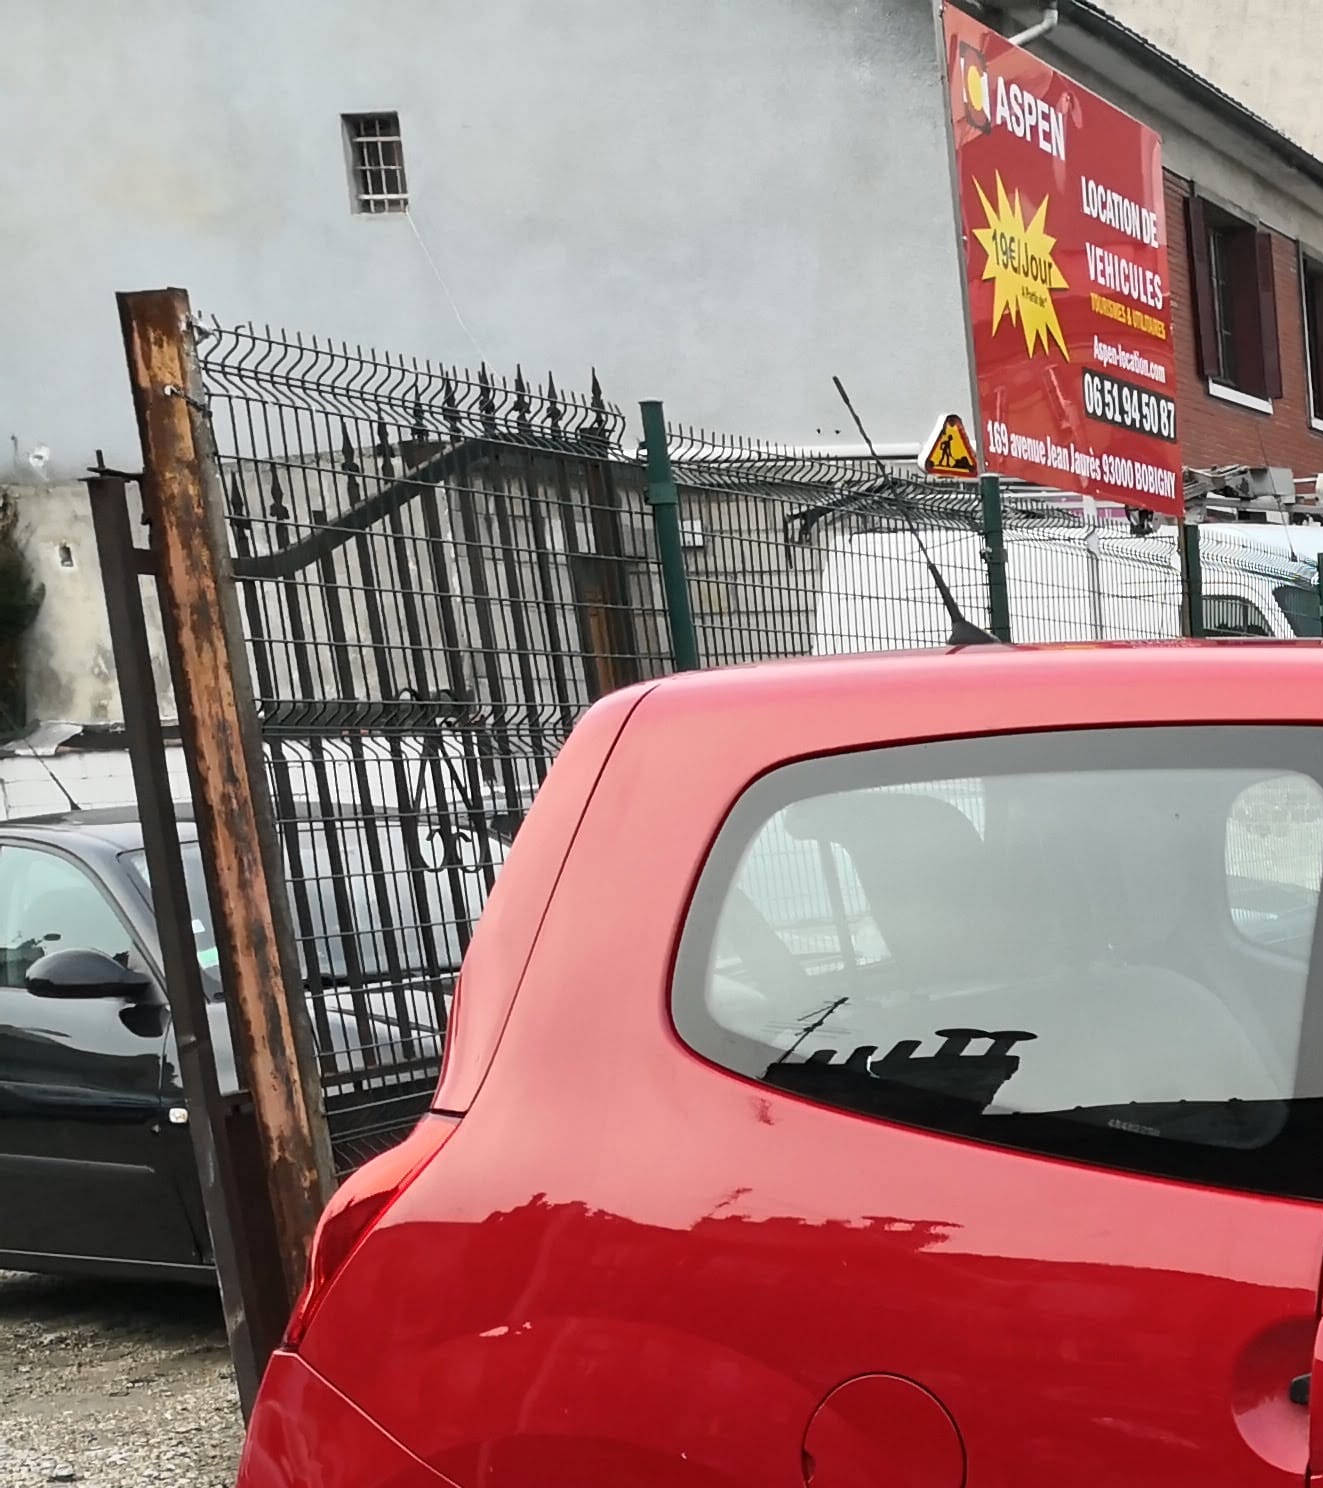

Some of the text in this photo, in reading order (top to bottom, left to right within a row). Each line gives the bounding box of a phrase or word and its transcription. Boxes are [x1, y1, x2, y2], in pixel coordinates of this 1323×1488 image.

[996, 76, 1065, 161] ASPEN
[1081, 175, 1159, 249] LOCATION DE
[1085, 242, 1163, 310] VEHICULES
[1094, 335, 1166, 384] Aspen-location.com
[1084, 373, 1175, 439] 06 51 94 50 87
[987, 420, 1176, 499] 169 avenue Jean Jaurès 93000 BOBIGNY
